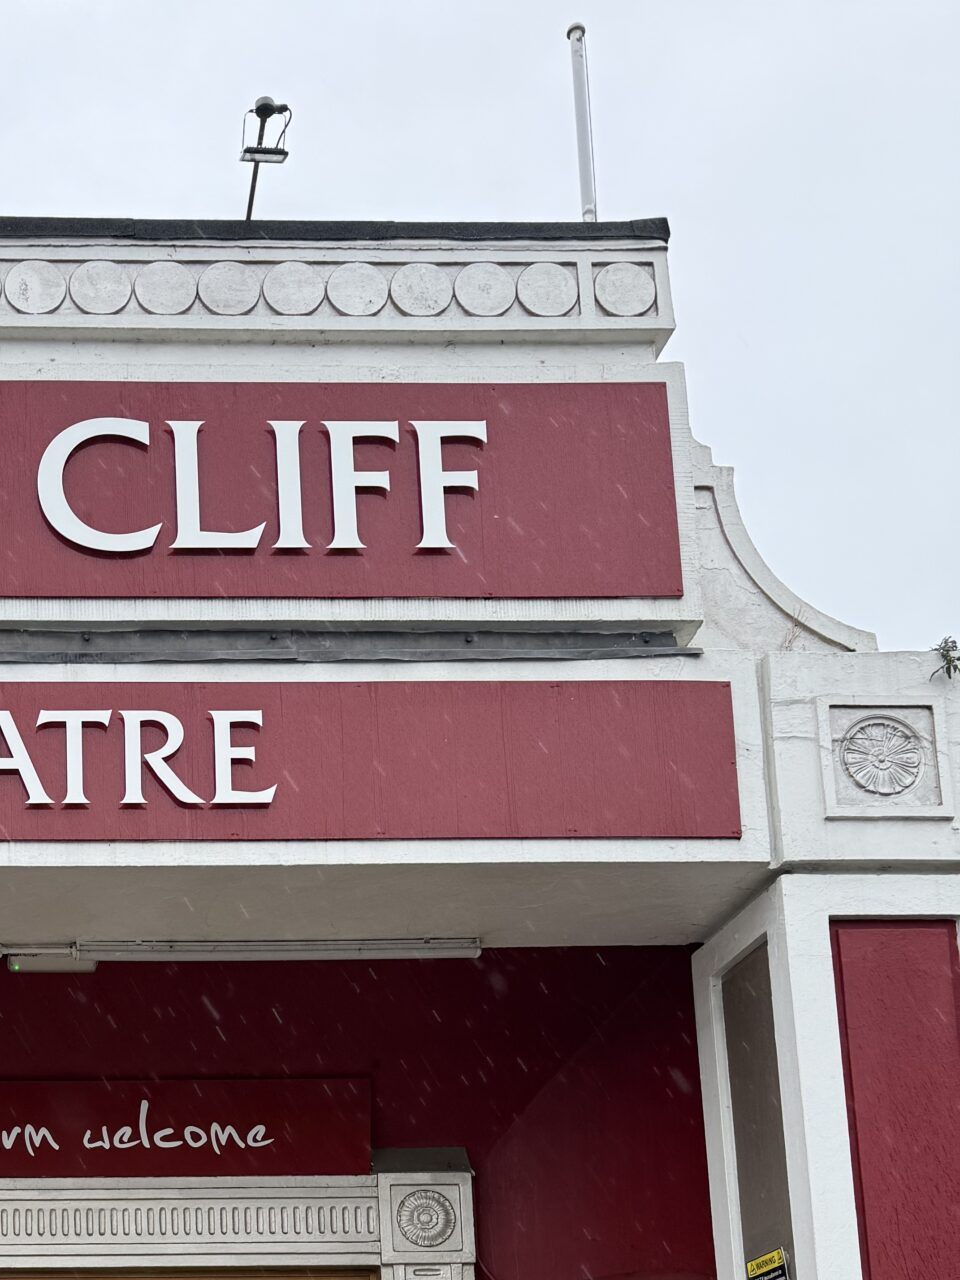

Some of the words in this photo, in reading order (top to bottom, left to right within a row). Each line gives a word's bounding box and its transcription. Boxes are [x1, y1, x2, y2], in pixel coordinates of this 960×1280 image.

[37, 417, 488, 552] CLIFF
[83, 1100, 275, 1150] welcome
[756, 1256, 776, 1271] WARNING
